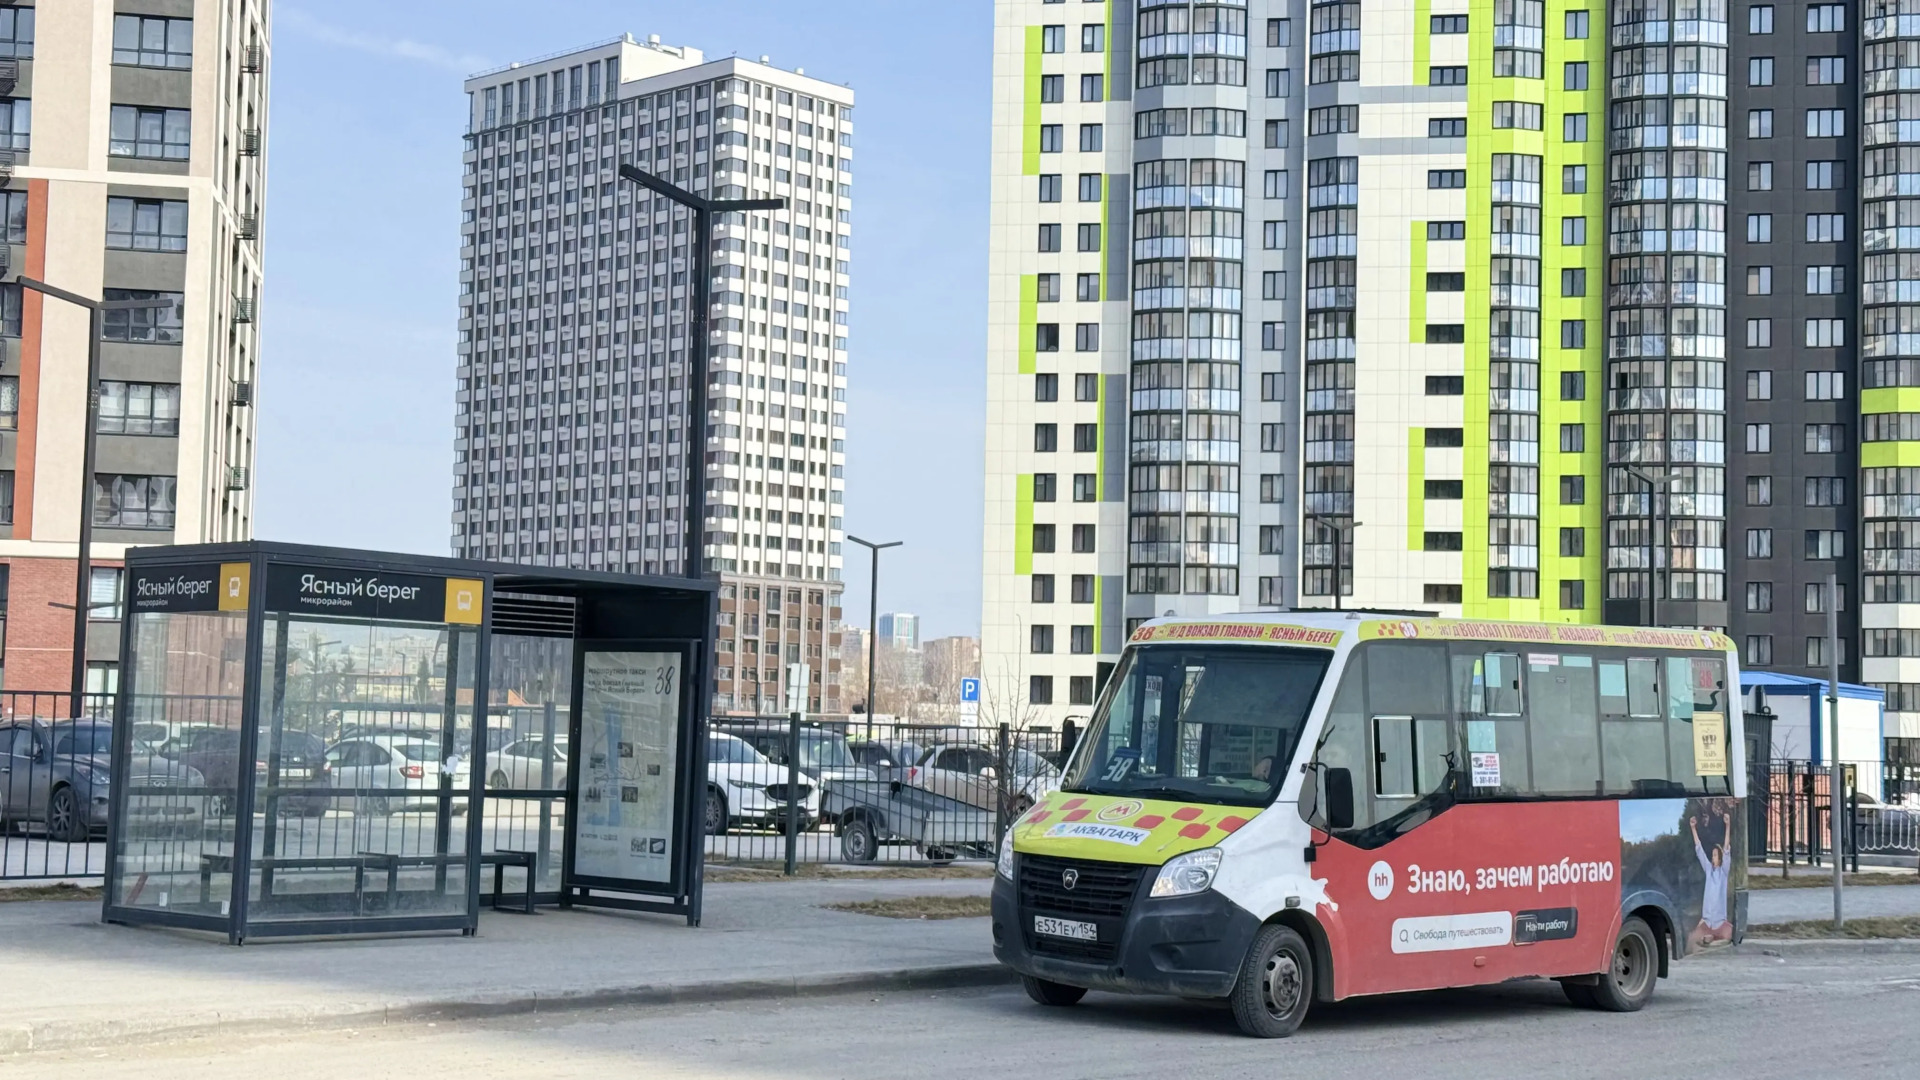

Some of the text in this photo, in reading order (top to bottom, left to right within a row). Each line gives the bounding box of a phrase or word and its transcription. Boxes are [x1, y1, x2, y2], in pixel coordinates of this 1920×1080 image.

[137, 575, 212, 600] Ясный берег
[300, 574, 420, 604] Ясный берег
[136, 598, 168, 607] микрорайон
[300, 596, 353, 607] микрорайон
[1131, 626, 1156, 641] 38
[1186, 625, 1220, 638] ВОКЗАЛ
[1220, 624, 1265, 638] ГЛАВНЫЙ
[1269, 626, 1307, 640] ЯСНЫЙ
[1306, 630, 1336, 644] БЕРЕГ
[1400, 622, 1417, 638] 38
[1458, 622, 1501, 638] ВОКЗАЛ
[1556, 626, 1607, 642] АКВАПАРК
[1672, 633, 1697, 647] БЕРЕГ
[655, 665, 675, 695] 38
[1699, 668, 1713, 688] 38
[965, 681, 975, 698] P
[1100, 756, 1134, 782] 38
[1069, 825, 1144, 842] АКВАПАРК
[1374, 872, 1388, 887] hh
[1407, 856, 1614, 895] Знаю, зачем работаю
[1037, 918, 1096, 936] Е531ЕУ 154
[1413, 925, 1504, 940] Свобода путешествовать
[1545, 918, 1568, 933] работу
